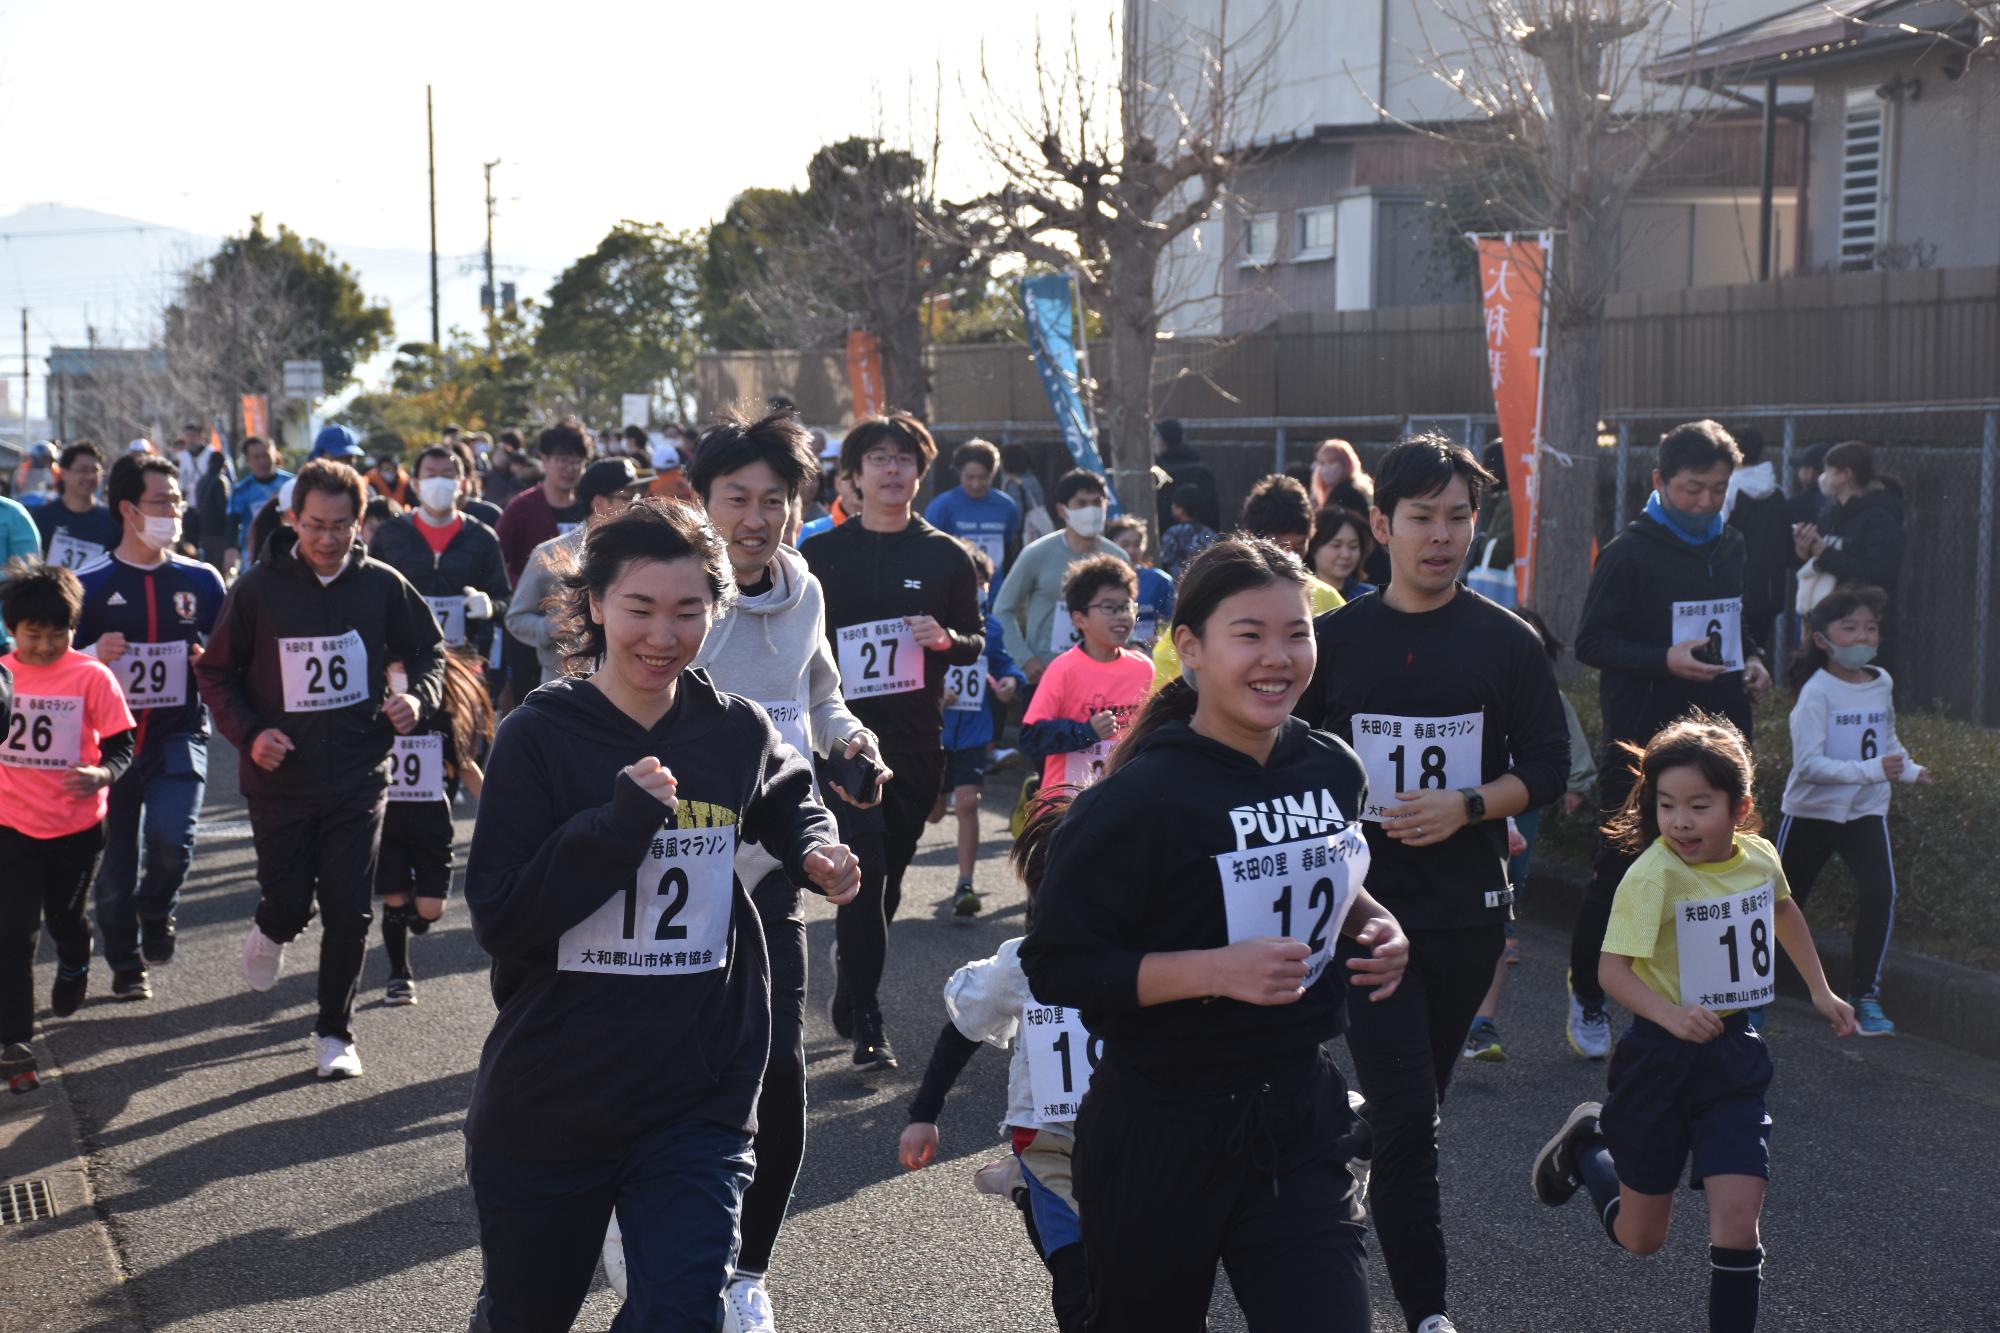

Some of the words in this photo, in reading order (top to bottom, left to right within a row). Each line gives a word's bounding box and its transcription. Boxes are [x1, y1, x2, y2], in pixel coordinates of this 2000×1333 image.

[61, 548, 87, 570] 37
[875, 621, 912, 636] 春風マラソ
[305, 655, 348, 693] 26
[860, 638, 898, 679] 27
[129, 660, 167, 694] 29
[951, 668, 980, 697] 36
[9, 712, 53, 752] 26
[1361, 718, 1402, 738] 矢田の里
[1414, 720, 1475, 739] 春風マラソン
[1861, 728, 1878, 761] 6
[1389, 745, 1446, 793] 18
[1229, 788, 1346, 852] PUMA
[650, 835, 727, 860] 春風マラソン
[1232, 852, 1289, 883] 矢田の里
[1302, 837, 1362, 872] 春風マラソン
[622, 867, 690, 941] 12
[1273, 877, 1335, 956] 12
[1685, 902, 1732, 922] 矢田の里
[581, 948, 713, 968] 大和郡山市体育協会
[1719, 918, 1771, 983] 18
[1027, 1007, 1065, 1026] 矢田の里
[1043, 1102, 1079, 1117] 大和郡山
